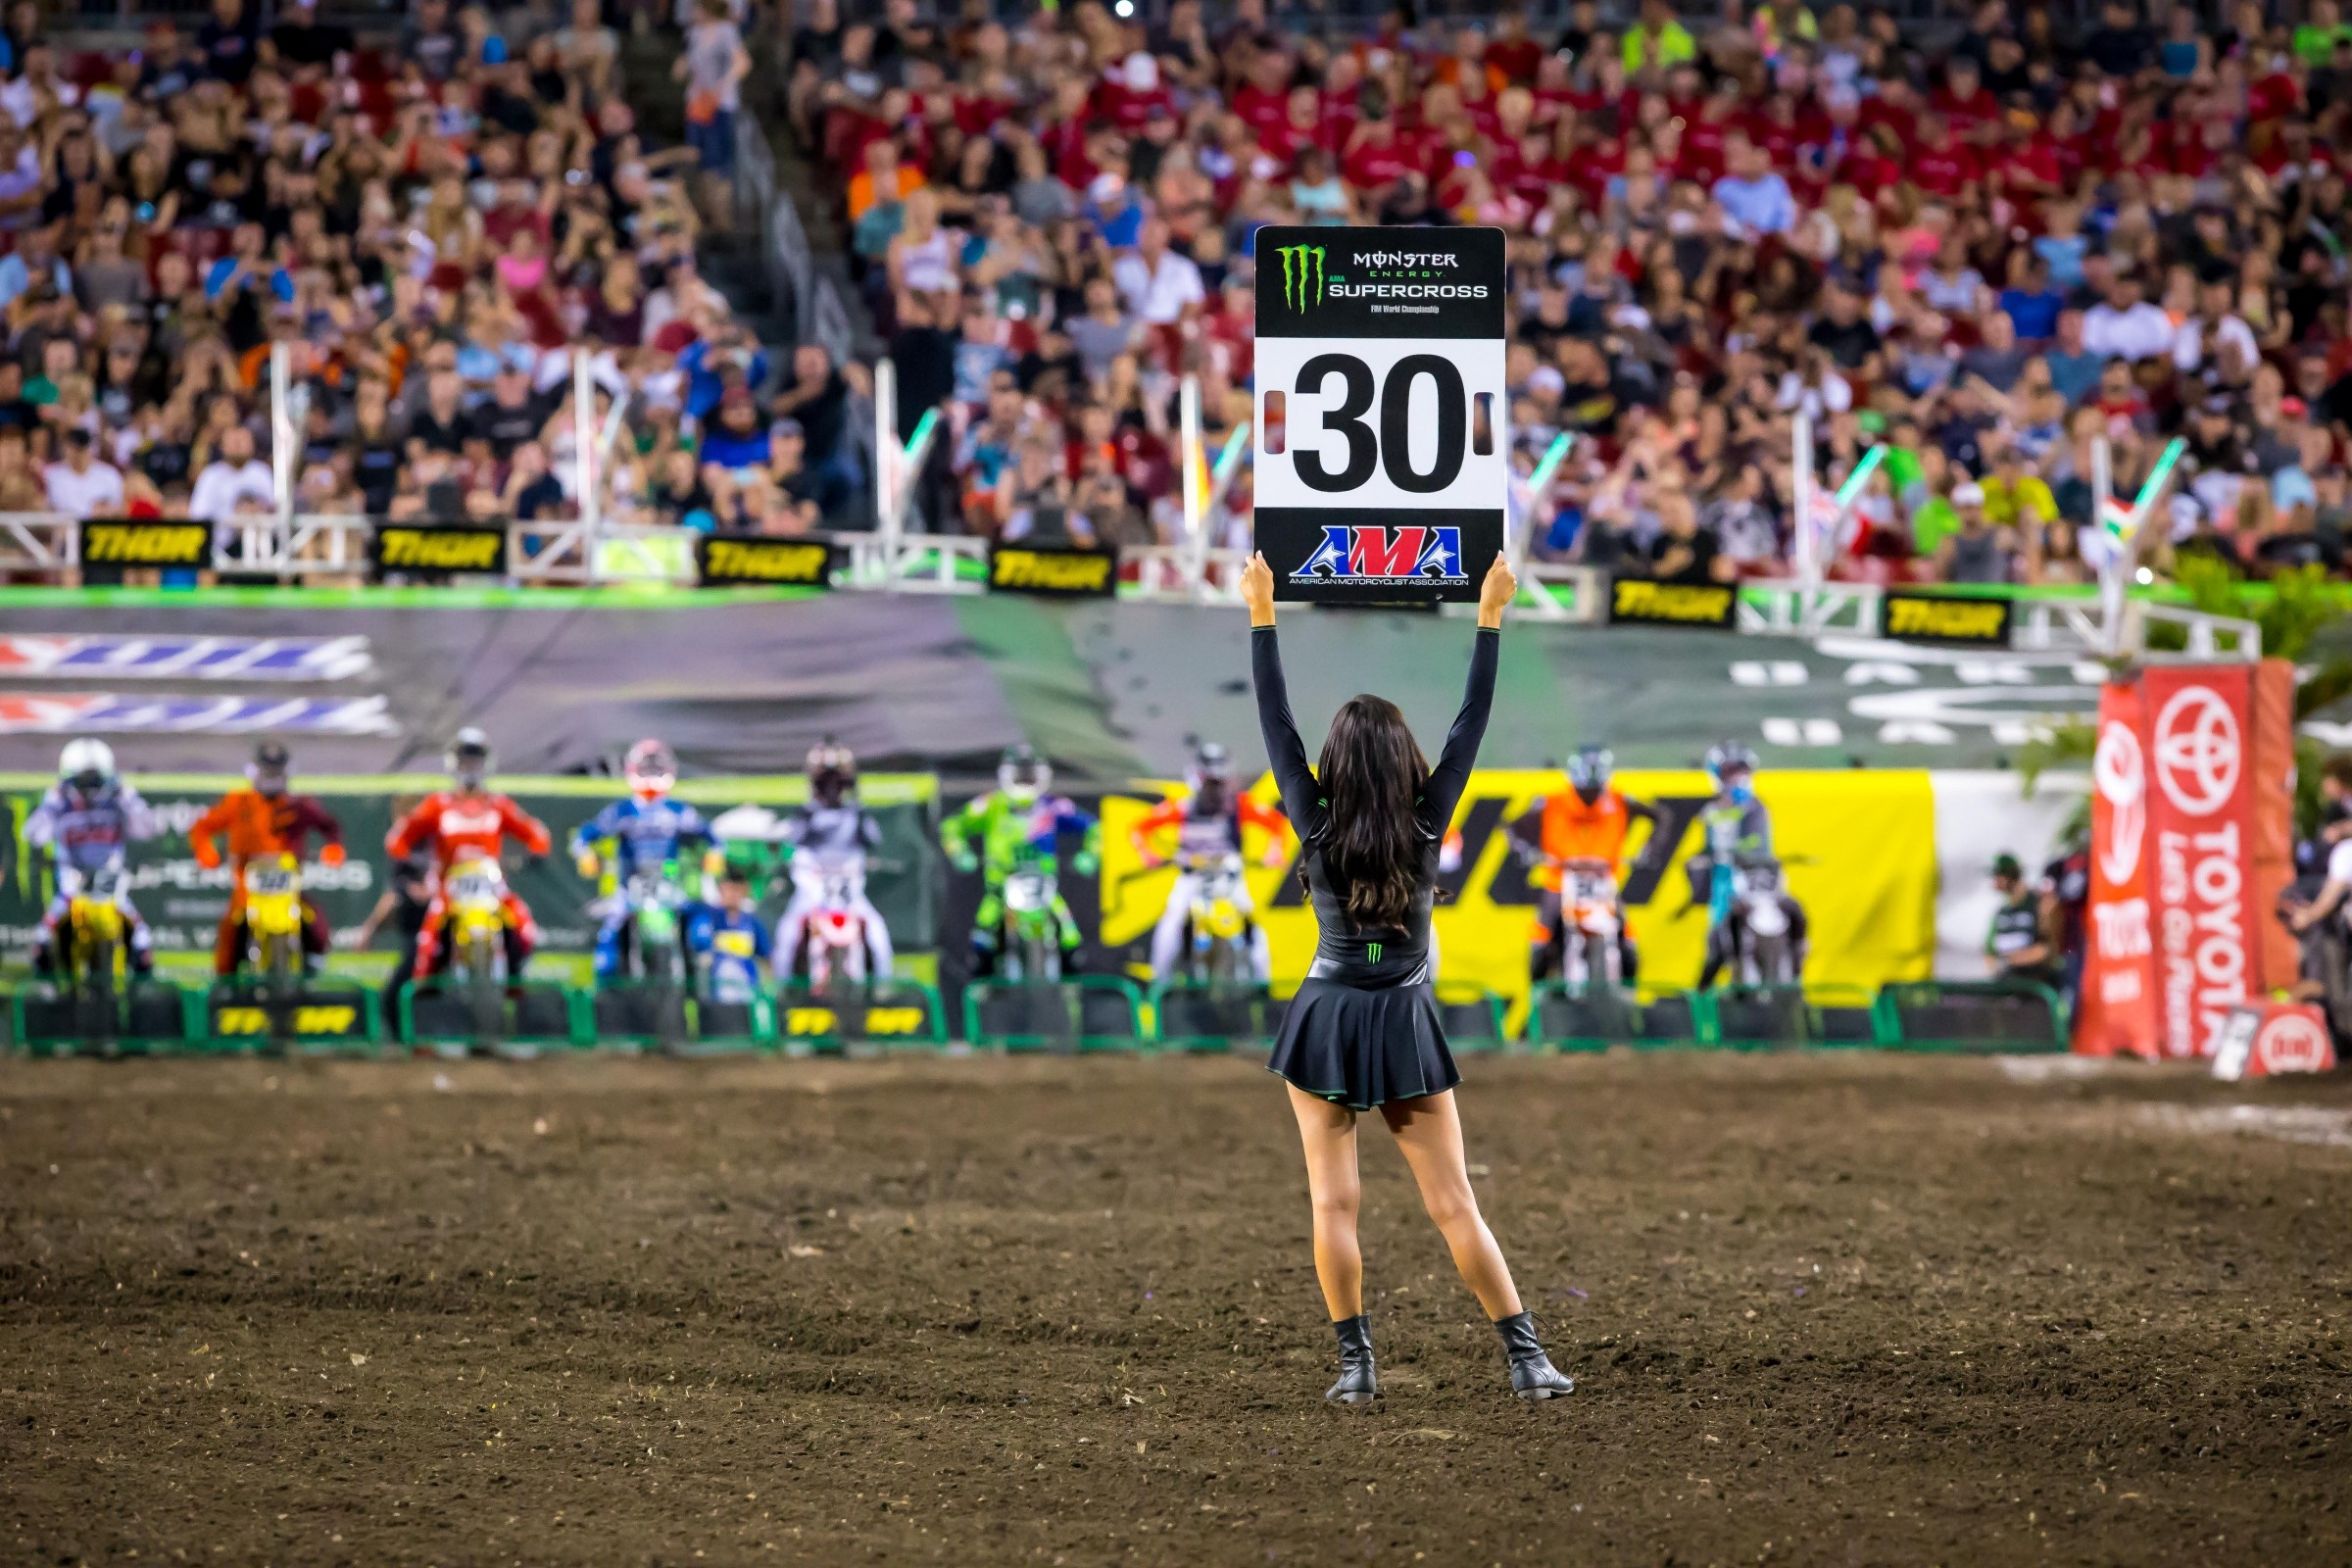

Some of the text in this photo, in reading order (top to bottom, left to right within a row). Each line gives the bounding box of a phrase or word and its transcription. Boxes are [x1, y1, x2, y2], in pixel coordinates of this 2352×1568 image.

[1352, 251, 1459, 269] MONSTER
[1329, 284, 1489, 298] SUPERCROSS
[1383, 305, 1400, 314] World
[1401, 305, 1440, 315] Championship
[1292, 353, 1467, 494] 30
[1289, 525, 1469, 578] AMA
